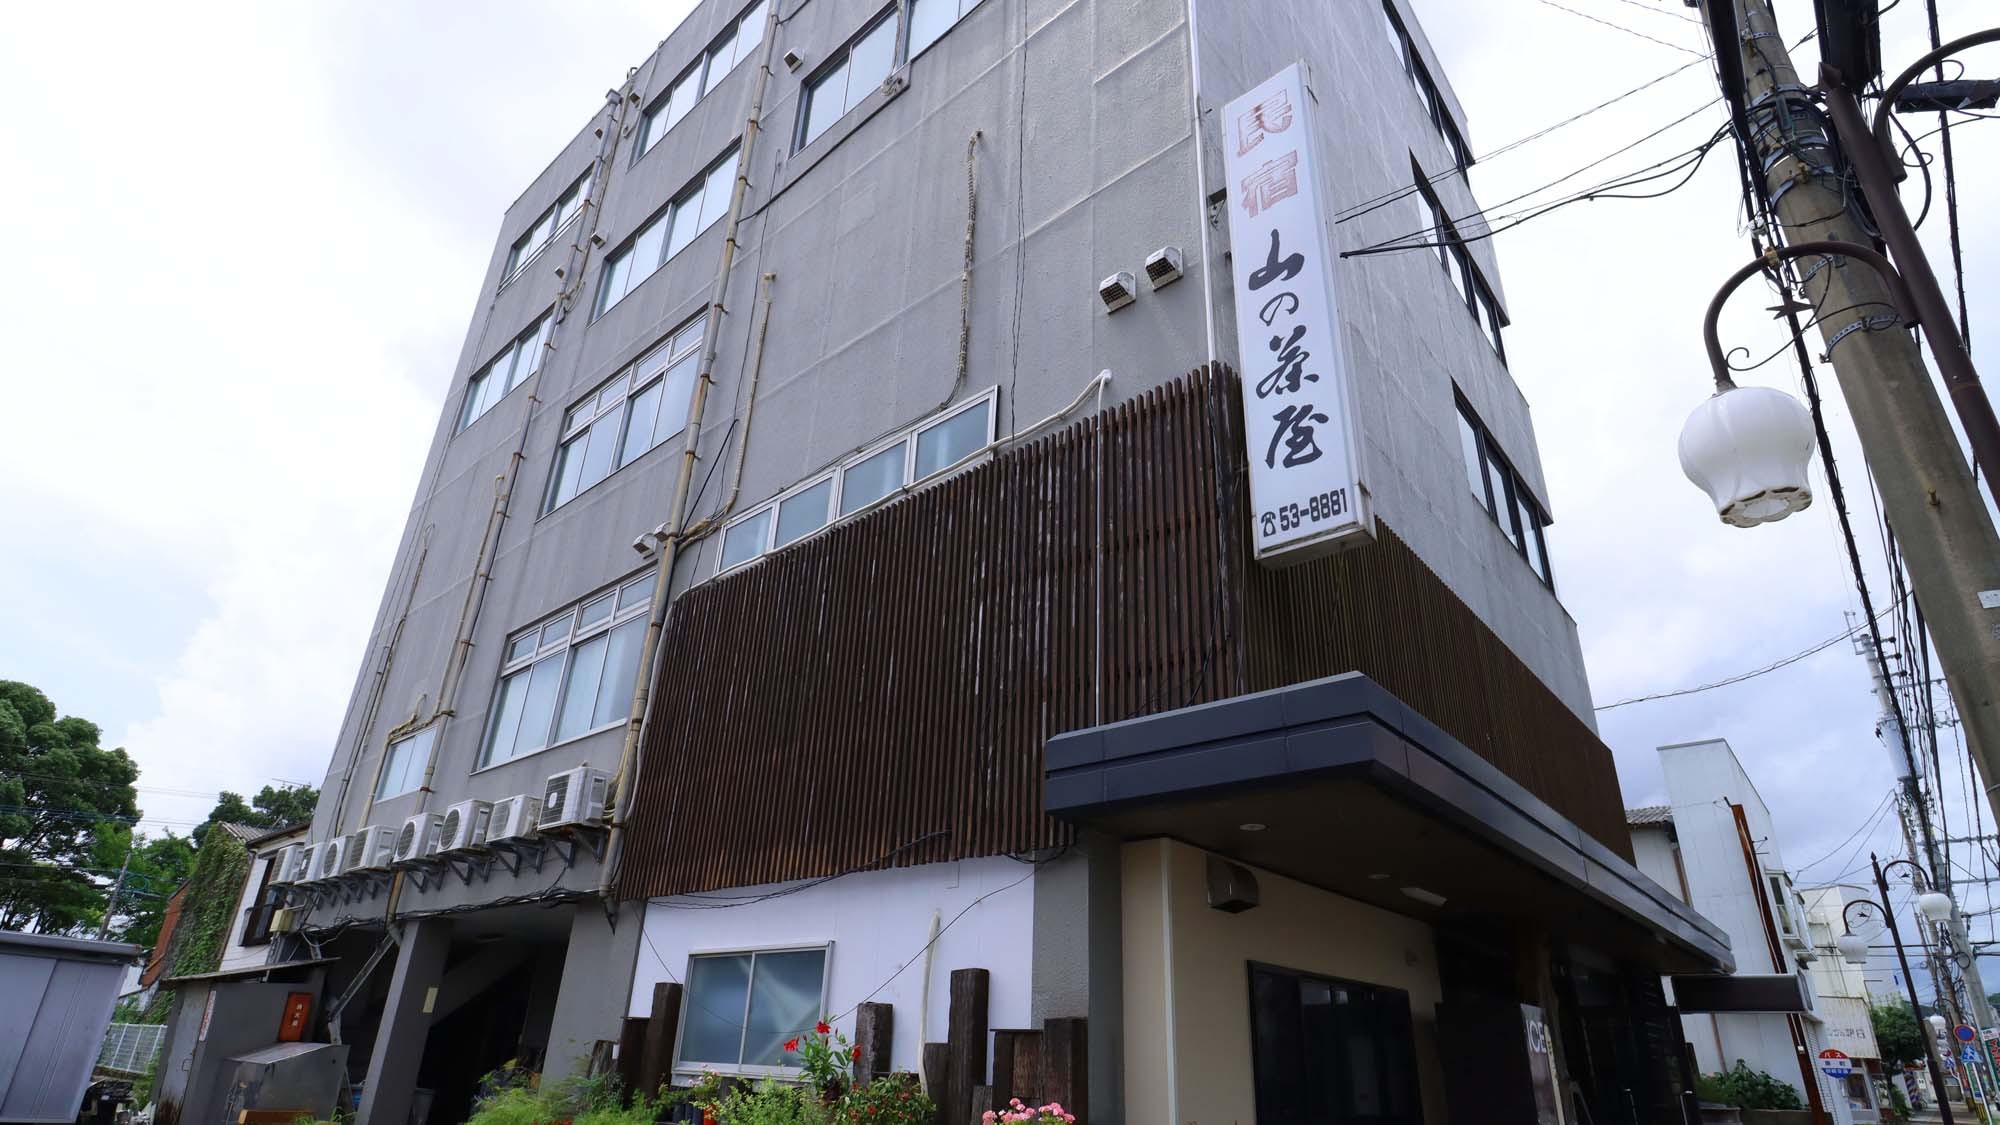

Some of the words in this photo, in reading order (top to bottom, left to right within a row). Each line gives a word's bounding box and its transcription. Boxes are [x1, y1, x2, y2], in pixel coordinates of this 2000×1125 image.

[1236, 87, 1299, 218] 民宿
[1248, 229, 1329, 470] 山の茶屋
[1279, 487, 1348, 532] 53-8881
